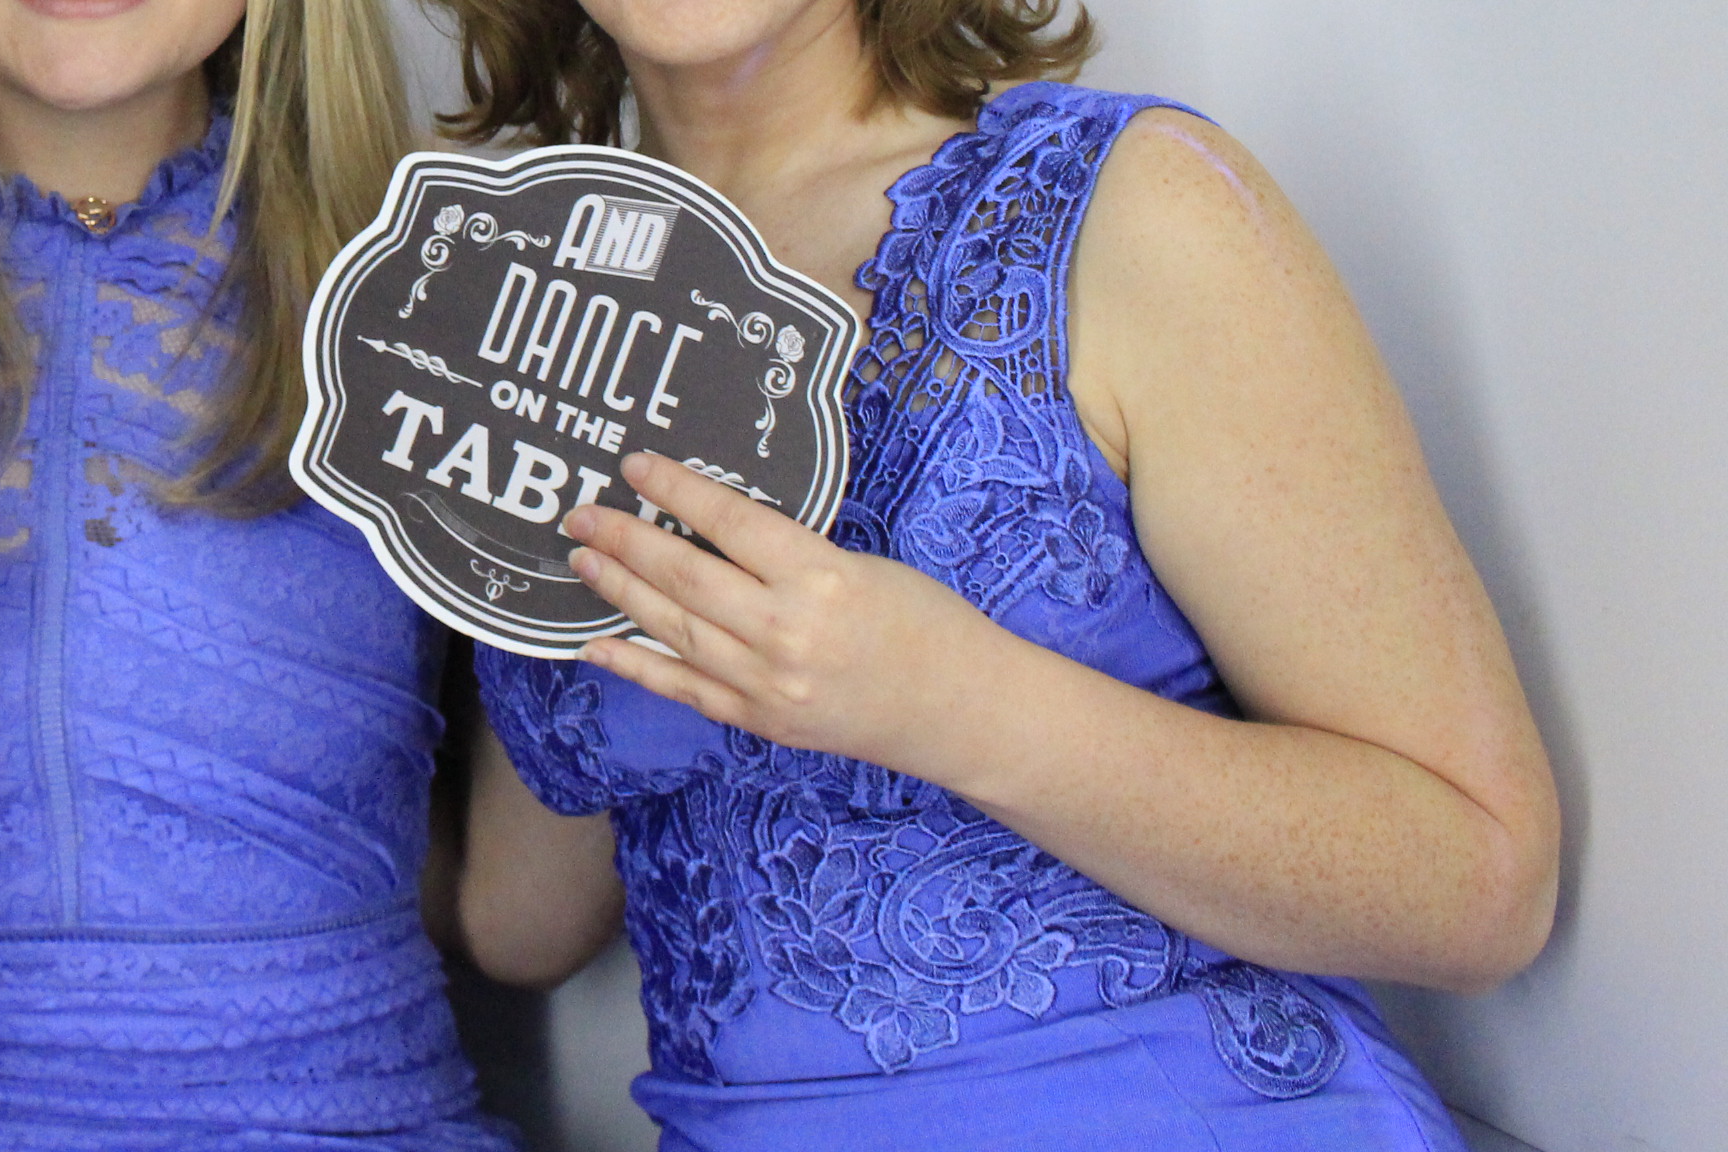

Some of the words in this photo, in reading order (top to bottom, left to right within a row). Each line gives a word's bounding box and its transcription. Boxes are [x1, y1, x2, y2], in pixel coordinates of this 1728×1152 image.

[553, 193, 672, 277] AND
[478, 262, 703, 429] DANCE
[490, 380, 547, 423] ON
[554, 401, 627, 454] THE
